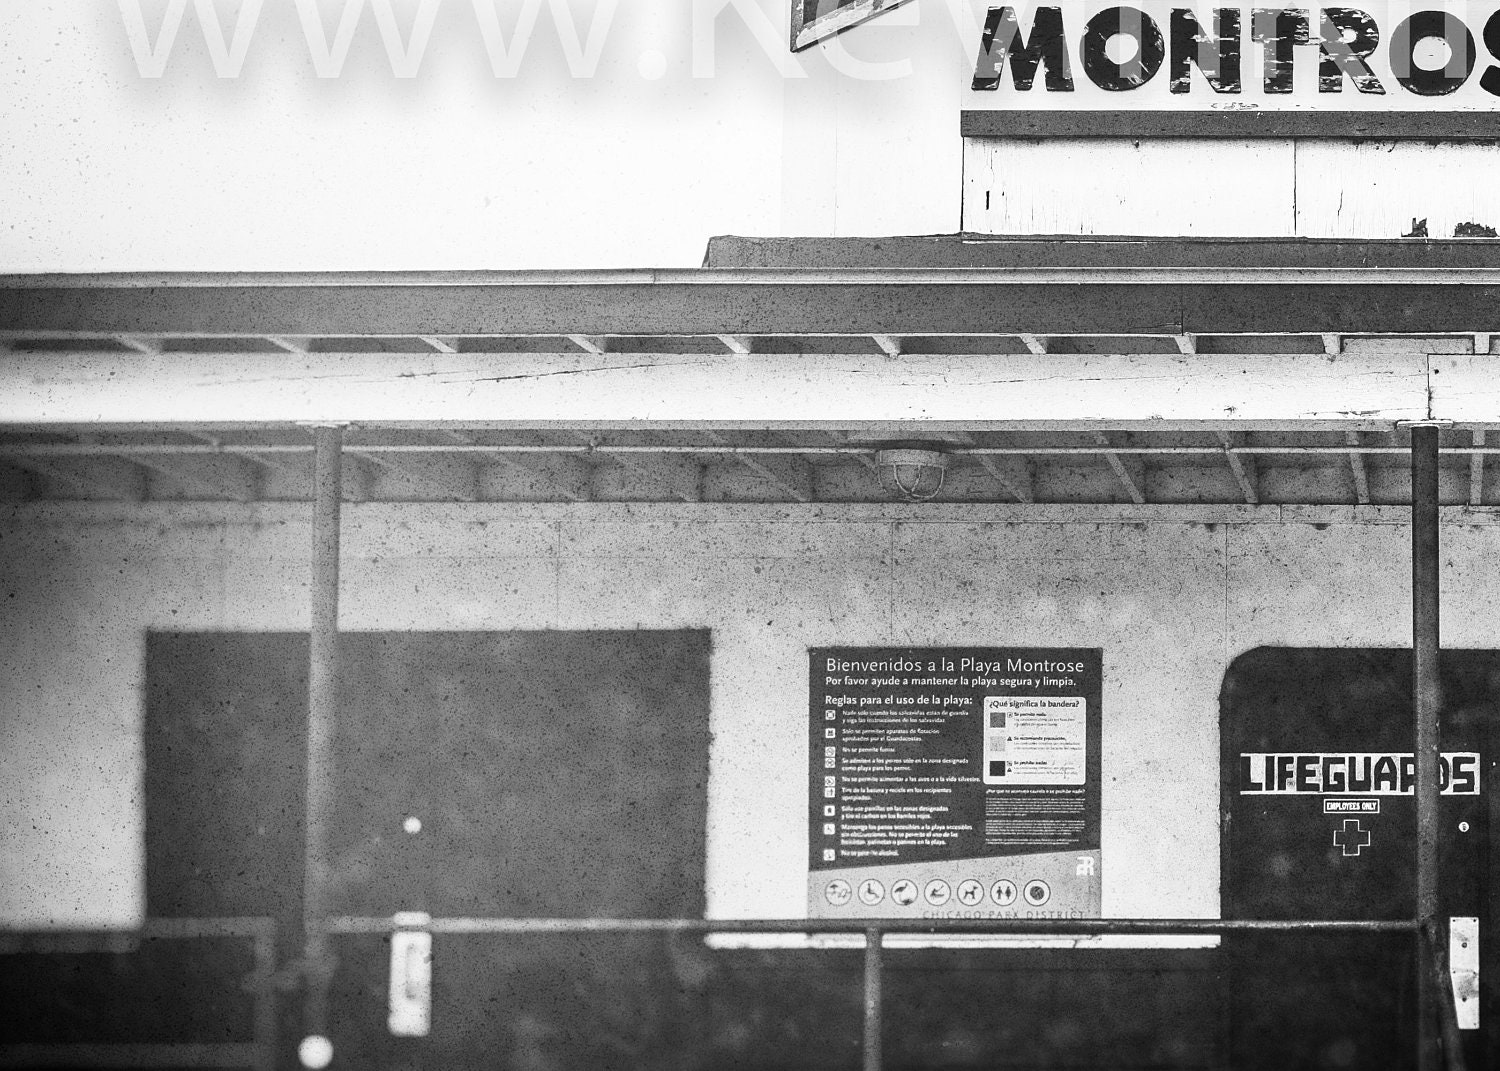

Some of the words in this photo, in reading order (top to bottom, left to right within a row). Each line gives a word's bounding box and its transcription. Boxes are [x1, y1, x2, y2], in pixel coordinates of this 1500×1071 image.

[826, 657, 922, 672] Bienvenidos
[928, 661, 936, 672] a
[942, 657, 954, 672] la
[961, 657, 1001, 676] Playa
[1007, 658, 1084, 672] Montrose
[825, 676, 841, 685] Por
[871, 675, 900, 688] ayude
[911, 677, 958, 686] mantener
[960, 676, 969, 685] la
[971, 676, 997, 688] playa
[1000, 677, 1032, 688] segura
[1034, 678, 1041, 688] y
[1043, 676, 1077, 688] limpia.
[825, 695, 857, 707] Reglas
[860, 697, 882, 707] para
[885, 695, 894, 705] el
[896, 697, 915, 705] uso
[917, 695, 930, 705] de
[932, 695, 941, 705] la
[943, 695, 973, 707] playa:
[1009, 700, 1039, 709] significa
[1048, 700, 1080, 708] bandera?
[1326, 802, 1360, 811] EMPLOYEES
[1362, 802, 1377, 811] ONLY
[923, 910, 982, 919] CHICAGO
[988, 910, 1019, 919] PARK
[1026, 910, 1085, 919] DISTRICT
